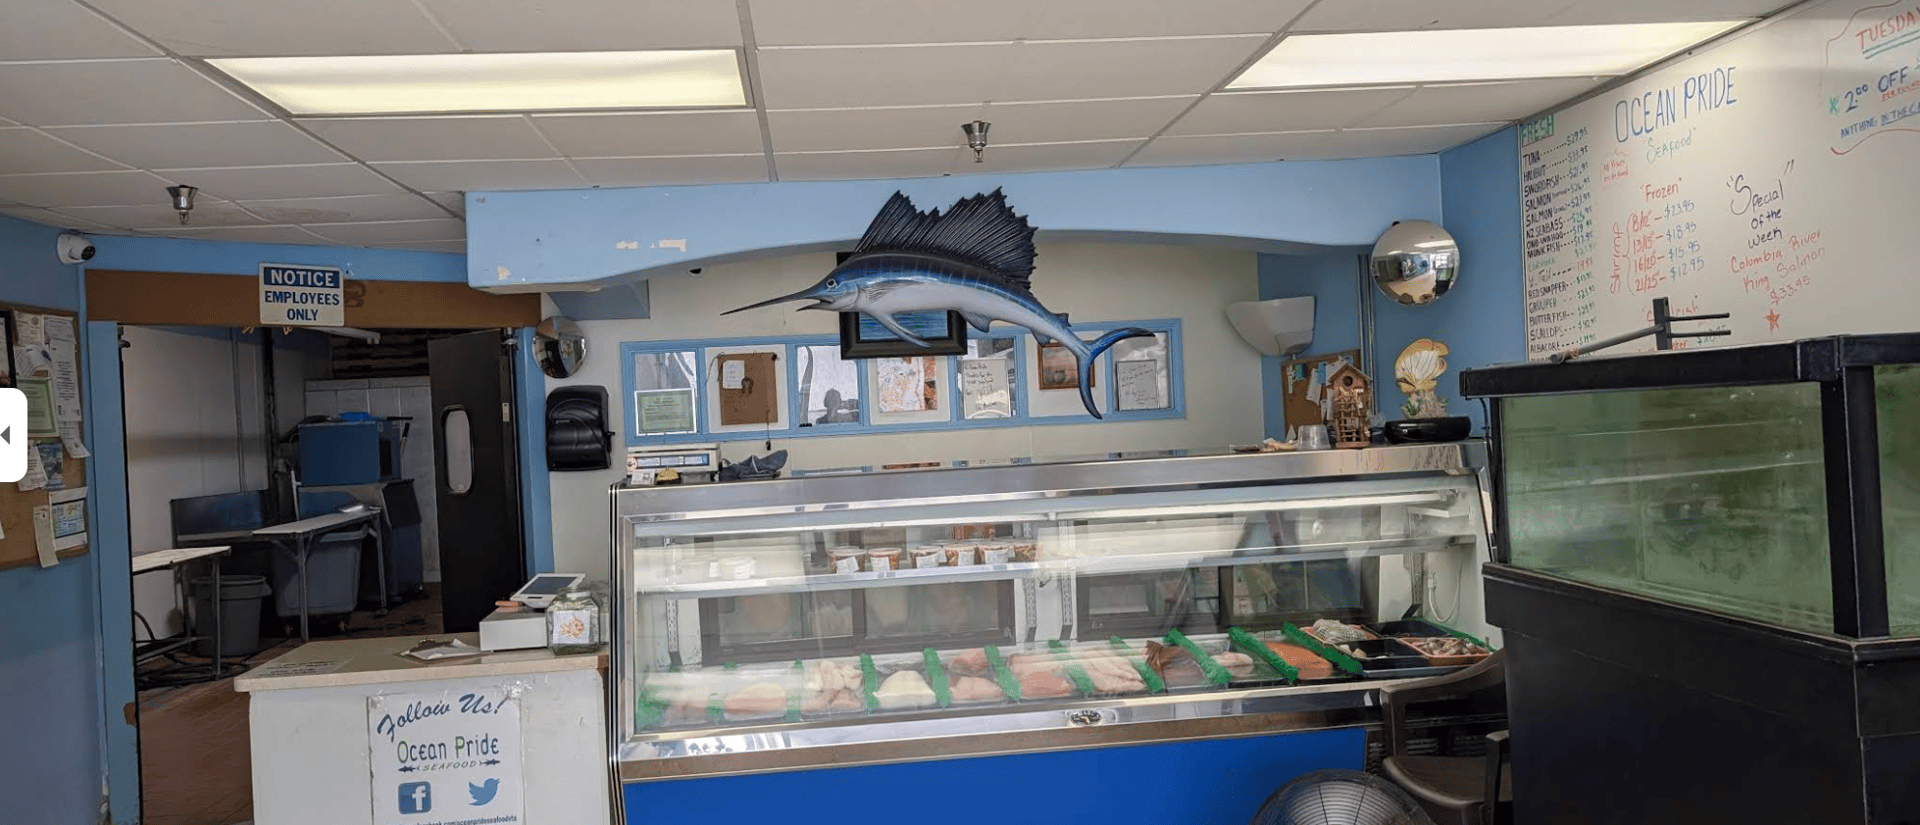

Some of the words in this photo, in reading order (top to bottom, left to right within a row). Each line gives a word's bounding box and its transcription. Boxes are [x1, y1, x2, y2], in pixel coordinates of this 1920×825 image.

[1877, 66, 1909, 94] OFF
[1615, 86, 1676, 143] OCEAN
[1684, 66, 1737, 119] PRIDE
[1521, 113, 1552, 142] FRESH
[1522, 150, 1541, 167] TUNA
[1523, 164, 1546, 183] HALIBUT
[1525, 192, 1552, 213] SALMON
[1526, 207, 1553, 228] SALMON
[1765, 208, 1782, 222] the
[1610, 222, 1624, 294] Shrimp
[1730, 250, 1783, 274] Columbia
[1788, 229, 1822, 248] River
[270, 269, 335, 287] NOTICE
[1743, 272, 1771, 294] King
[1776, 247, 1826, 279] Salmon
[264, 290, 340, 306] EMPLOYEES
[1529, 297, 1557, 314] GROUPER
[286, 308, 319, 321] ONLY
[1530, 325, 1565, 342] SCALLOPS
[1530, 341, 1562, 354] ALBACORE
[376, 700, 451, 743] Follow
[458, 693, 511, 715] Us!
[397, 740, 447, 764] Ocean
[454, 732, 500, 760] Pride
[422, 760, 477, 772] SEAFOOD
